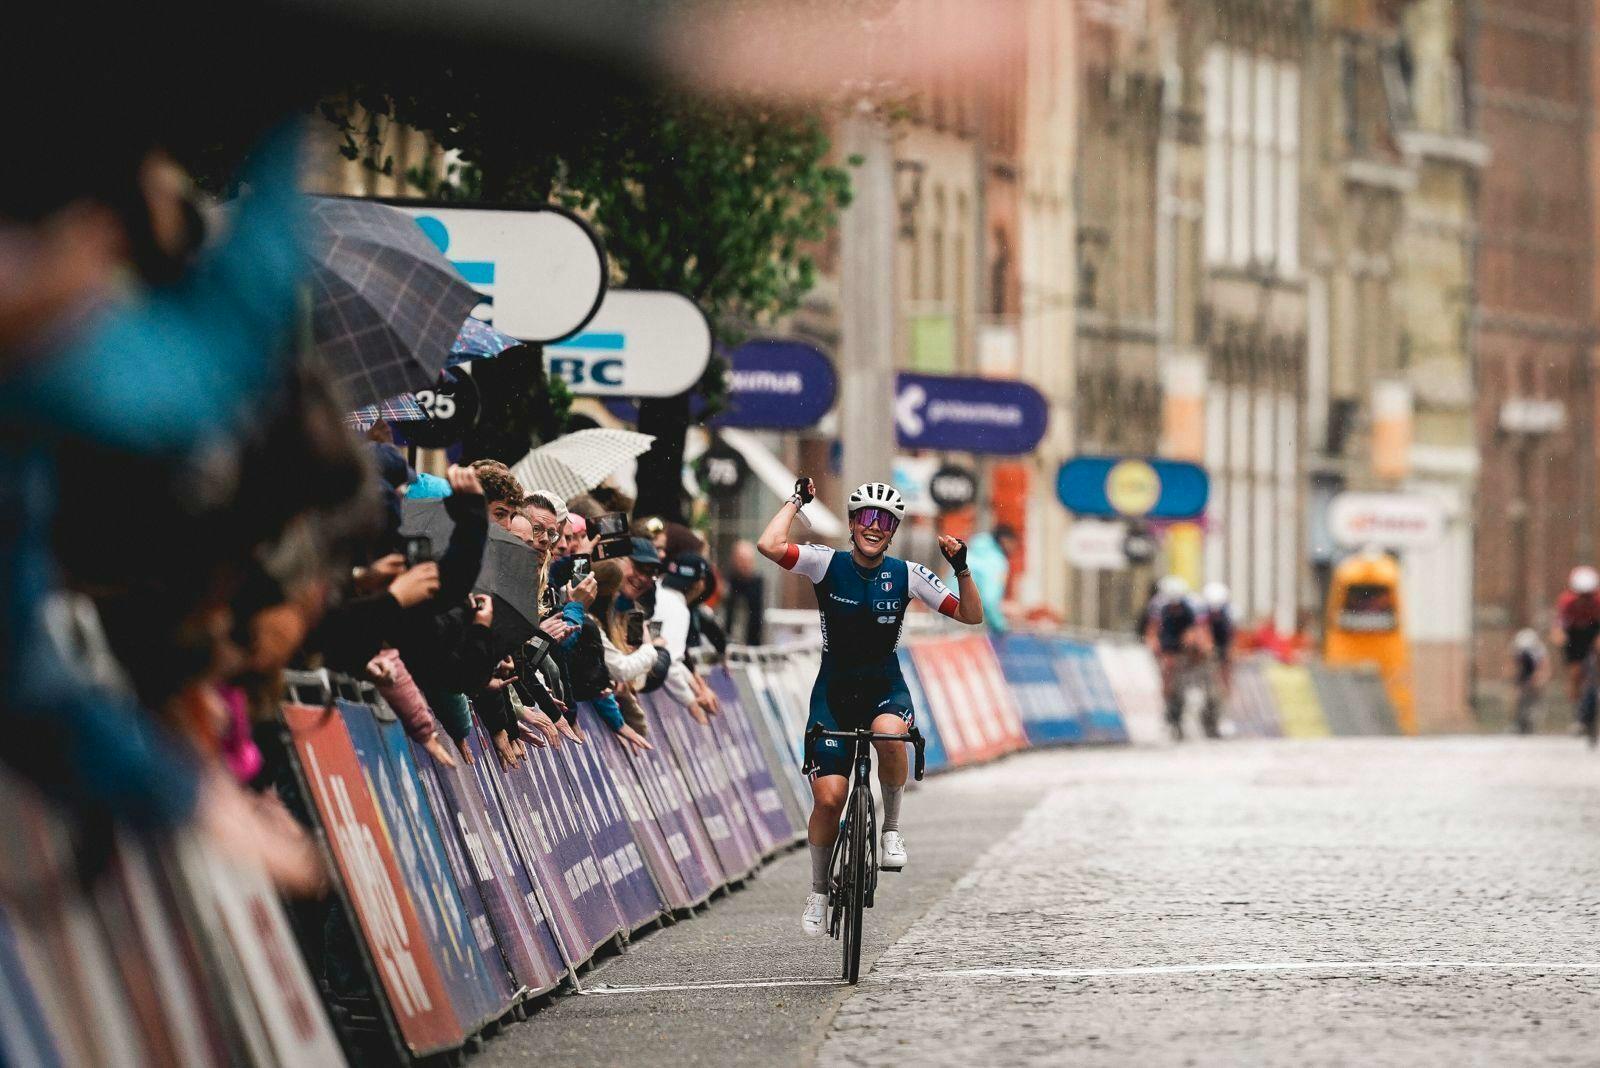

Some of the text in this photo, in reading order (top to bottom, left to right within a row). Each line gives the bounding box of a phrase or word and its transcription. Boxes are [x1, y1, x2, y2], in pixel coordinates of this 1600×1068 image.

[549, 357, 624, 386] BC
[415, 390, 456, 419] 25
[920, 565, 941, 588] CIC
[829, 593, 859, 605] LOOK
[876, 601, 899, 610] CIC
[820, 611, 829, 653] FRANCE
